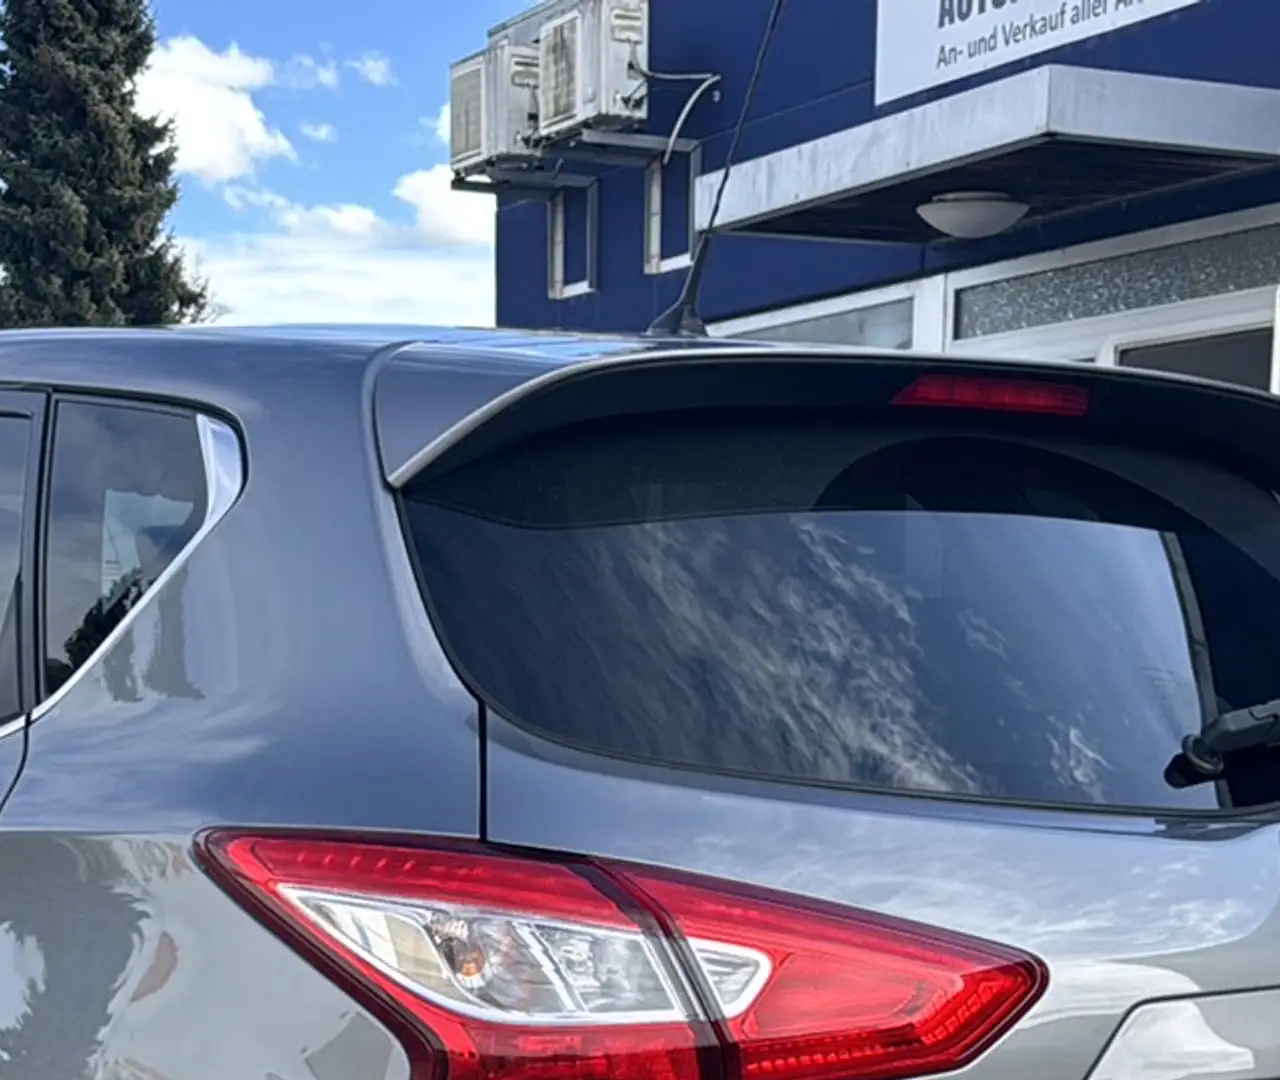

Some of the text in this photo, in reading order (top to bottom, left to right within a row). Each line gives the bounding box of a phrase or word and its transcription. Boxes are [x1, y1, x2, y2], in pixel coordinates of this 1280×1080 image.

[936, 44, 964, 69] An-
[966, 27, 998, 59] und
[1001, 2, 1068, 47] Verkauf
